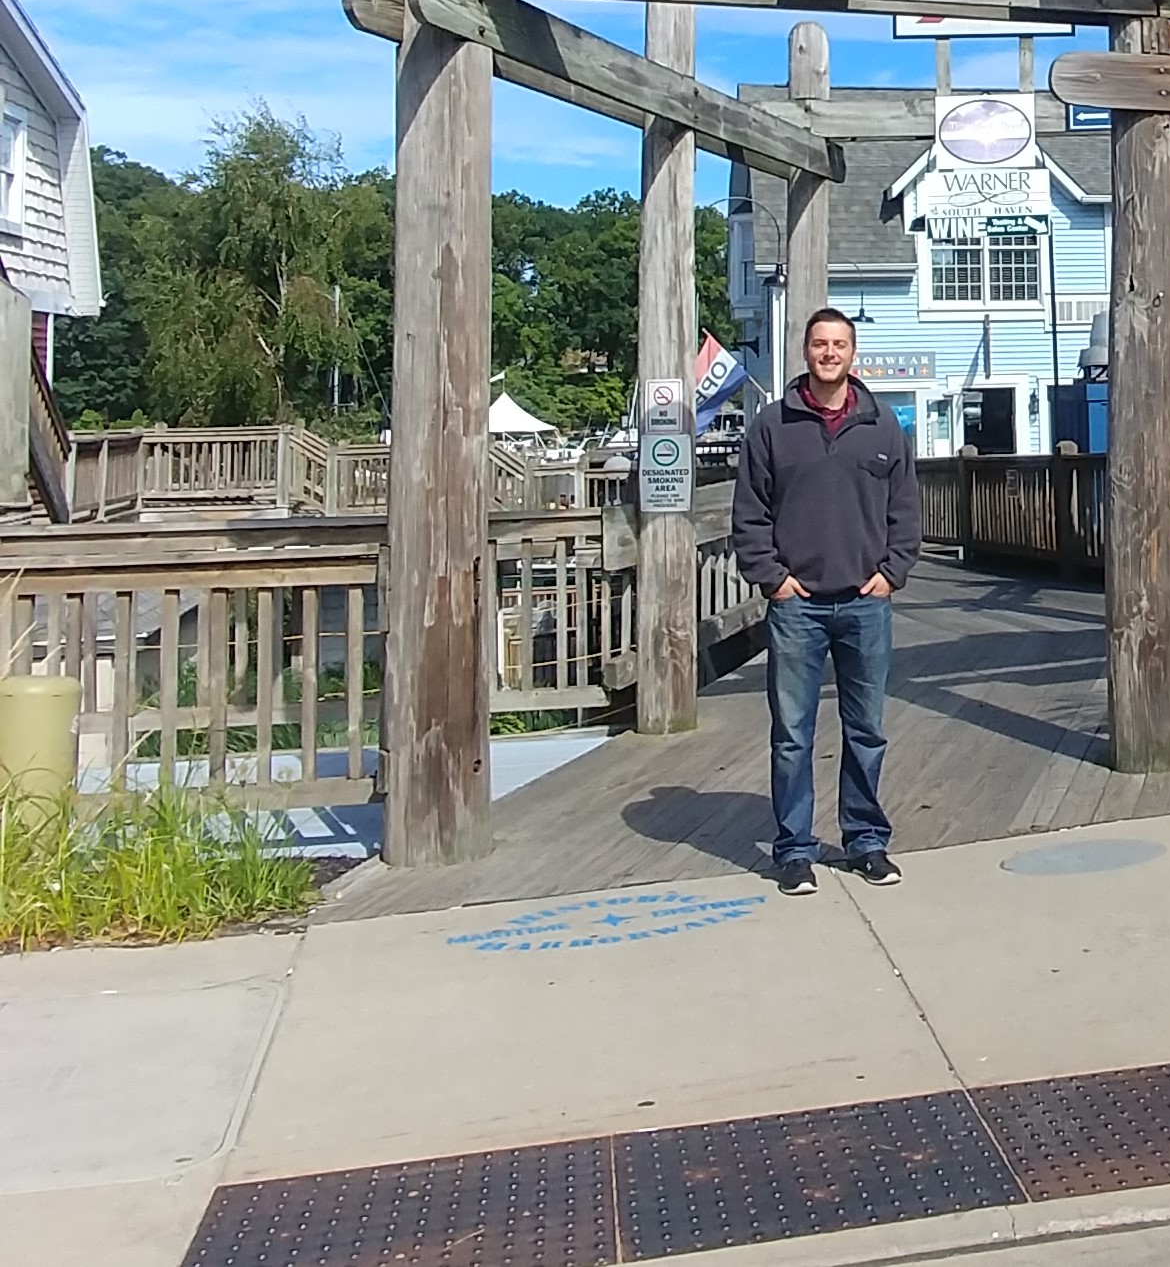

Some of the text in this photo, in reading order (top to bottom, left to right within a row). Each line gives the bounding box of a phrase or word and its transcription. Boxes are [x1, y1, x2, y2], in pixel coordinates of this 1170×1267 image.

[943, 171, 1032, 192] WARNER
[942, 208, 982, 216] SOUTH
[994, 206, 1033, 214] HAVEN
[928, 217, 988, 239] WINE
[641, 468, 690, 477] DESIGNATED
[654, 484, 676, 492] AREA
[446, 895, 767, 945] MARITIME DISTRICT
[475, 909, 753, 952] HARBORWALK
